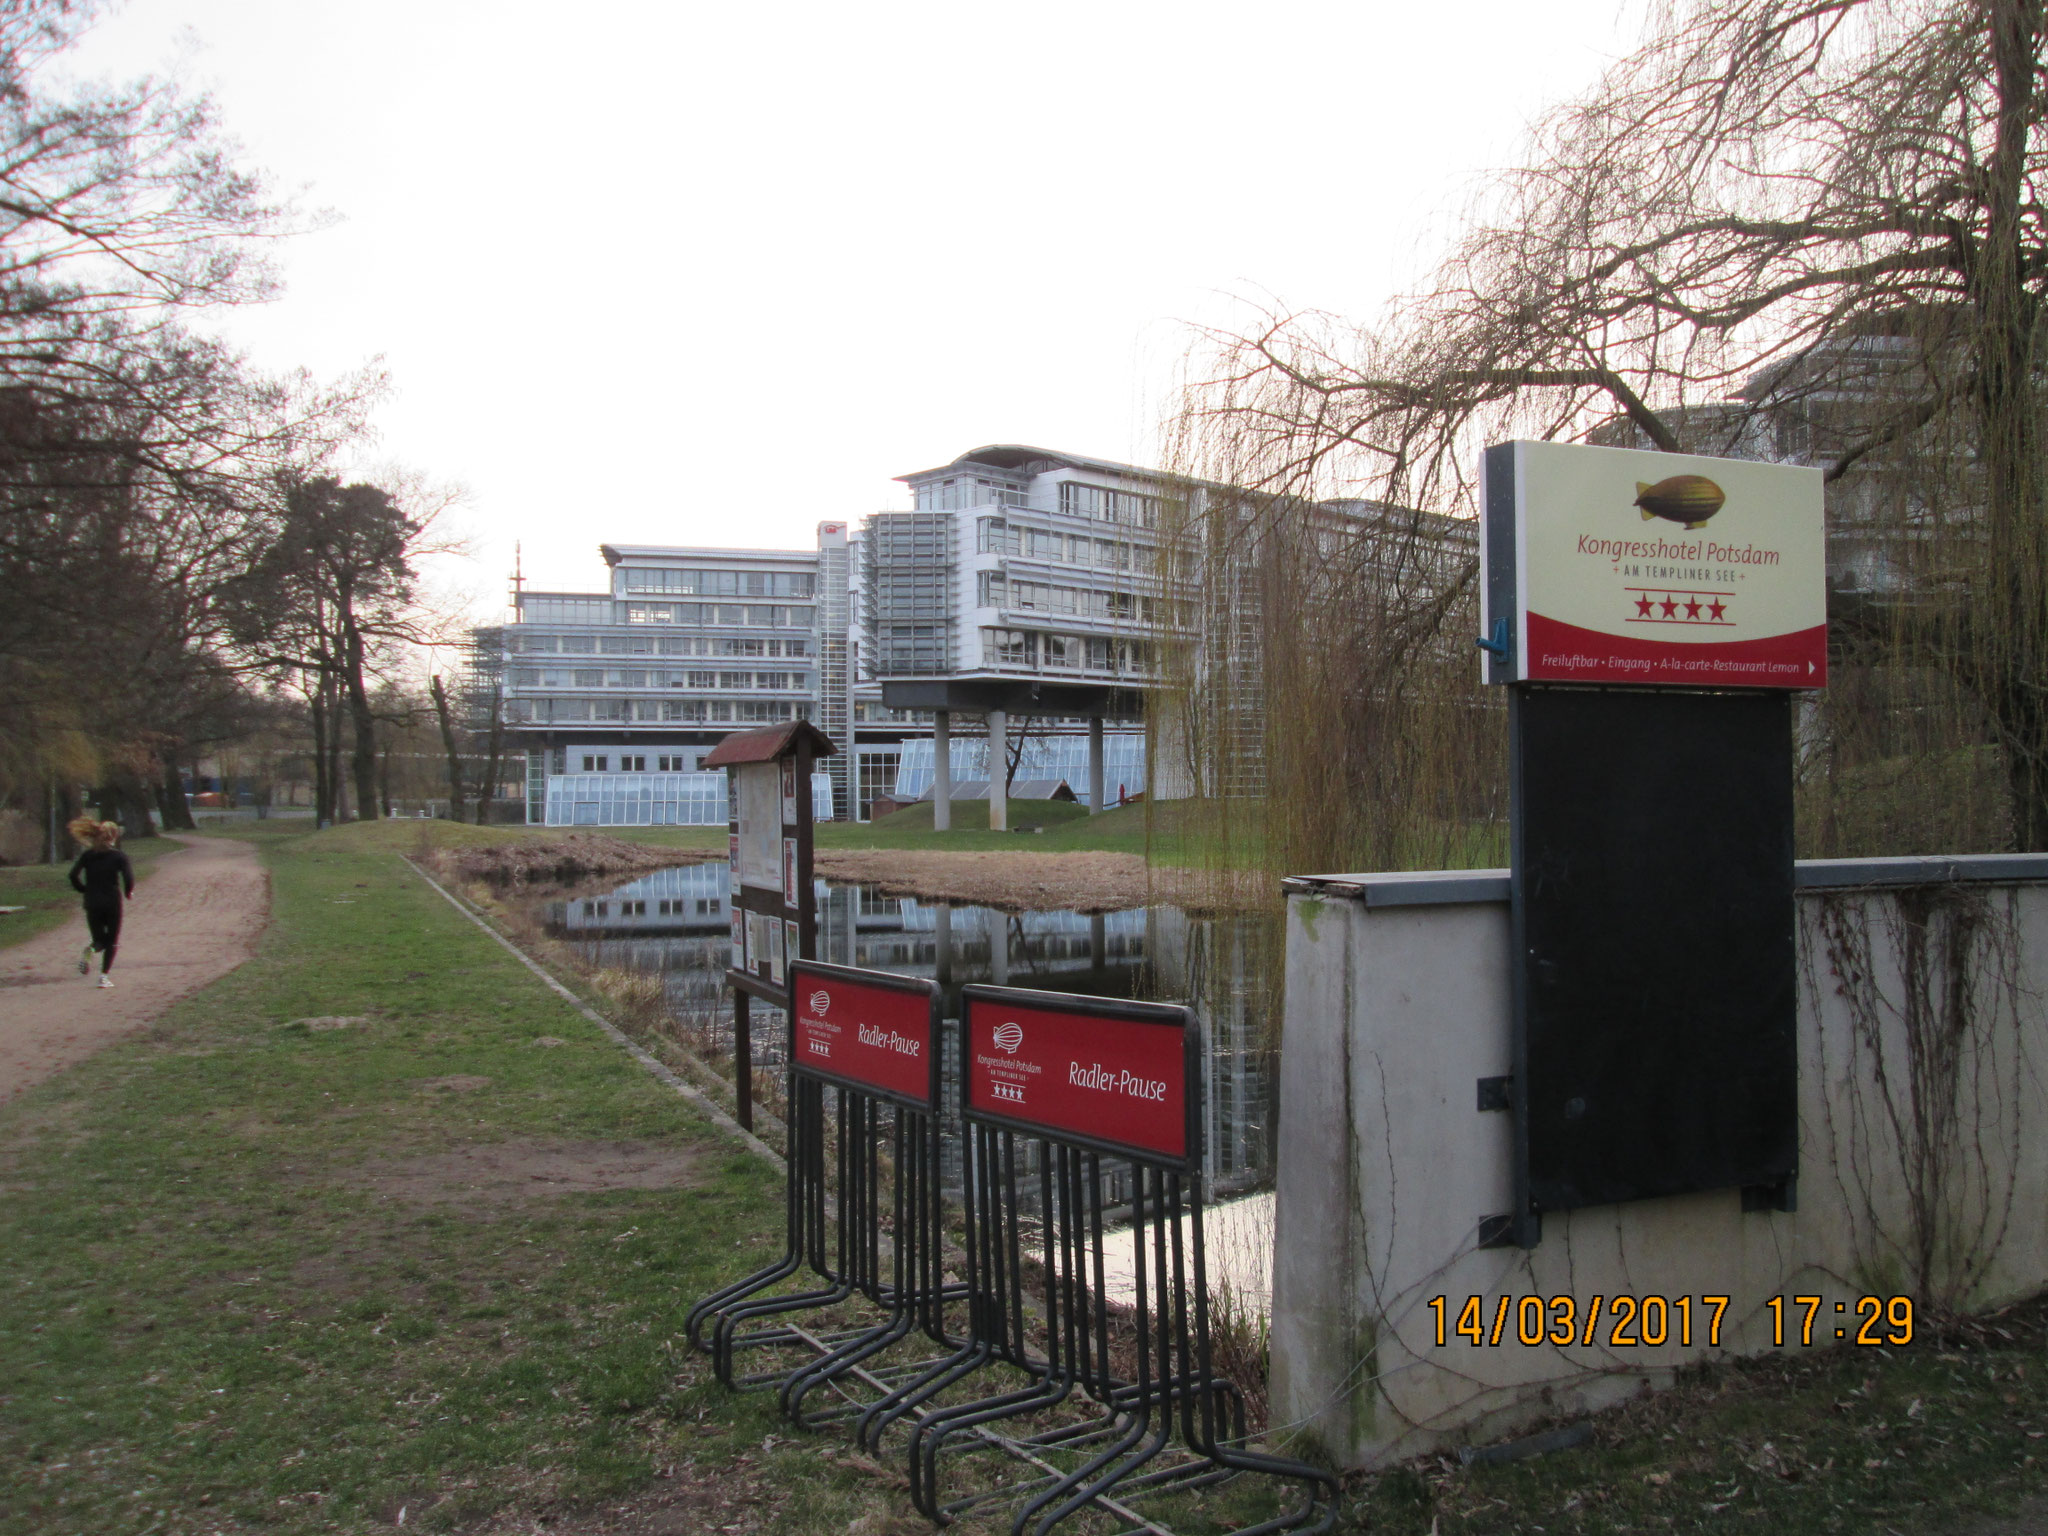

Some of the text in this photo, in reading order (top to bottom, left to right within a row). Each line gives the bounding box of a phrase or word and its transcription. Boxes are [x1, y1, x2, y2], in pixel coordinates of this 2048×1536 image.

[1577, 534, 1780, 566] Kongresshotel Potsdam
[1624, 564, 1736, 582] AM TEMPLINER SEE
[1541, 654, 1800, 673] Freiluftbar Eingang A-la-carte-Restaurant Lemon
[858, 1023, 920, 1057] Radler-Pause
[1069, 1061, 1167, 1102] Radler-Pause
